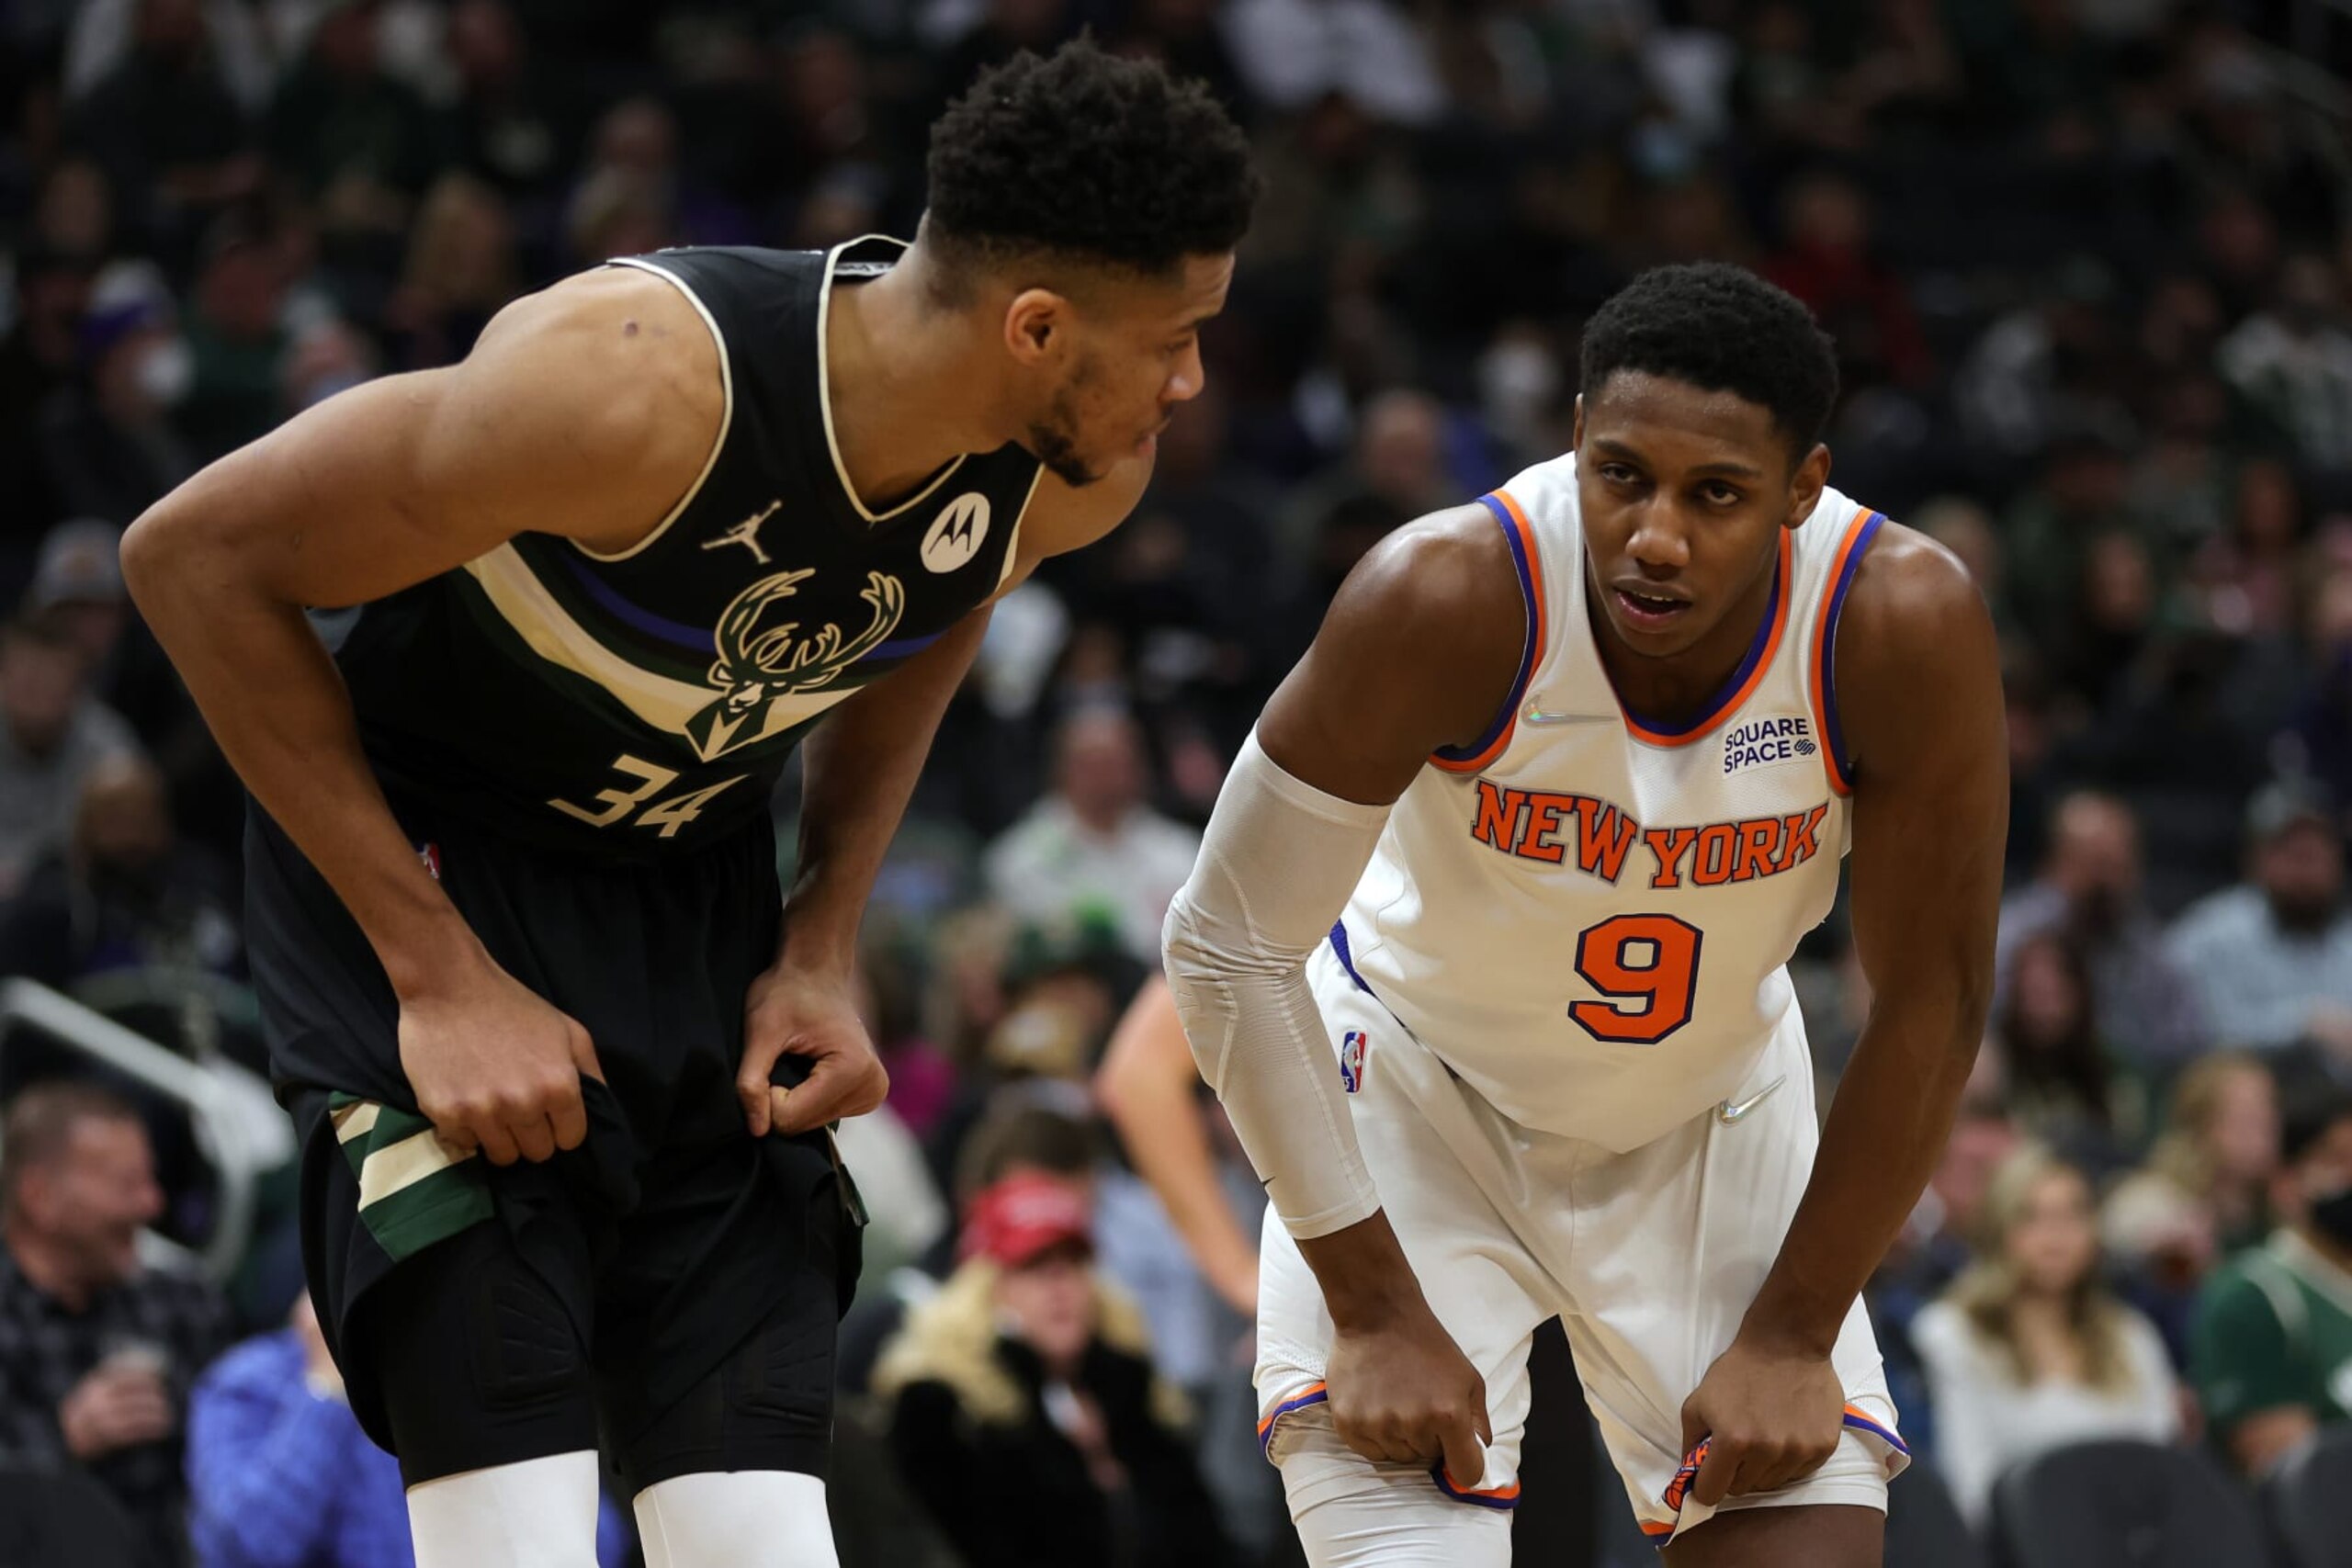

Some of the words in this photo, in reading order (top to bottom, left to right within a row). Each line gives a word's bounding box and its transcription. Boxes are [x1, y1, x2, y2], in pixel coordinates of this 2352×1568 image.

[1724, 718, 1809, 752] SQUARE
[1724, 739, 1792, 773] SPACE
[547, 753, 751, 838] 34
[1471, 779, 1640, 885] NEW
[1643, 799, 1829, 888] YORK
[1567, 913, 1703, 1044] 9
